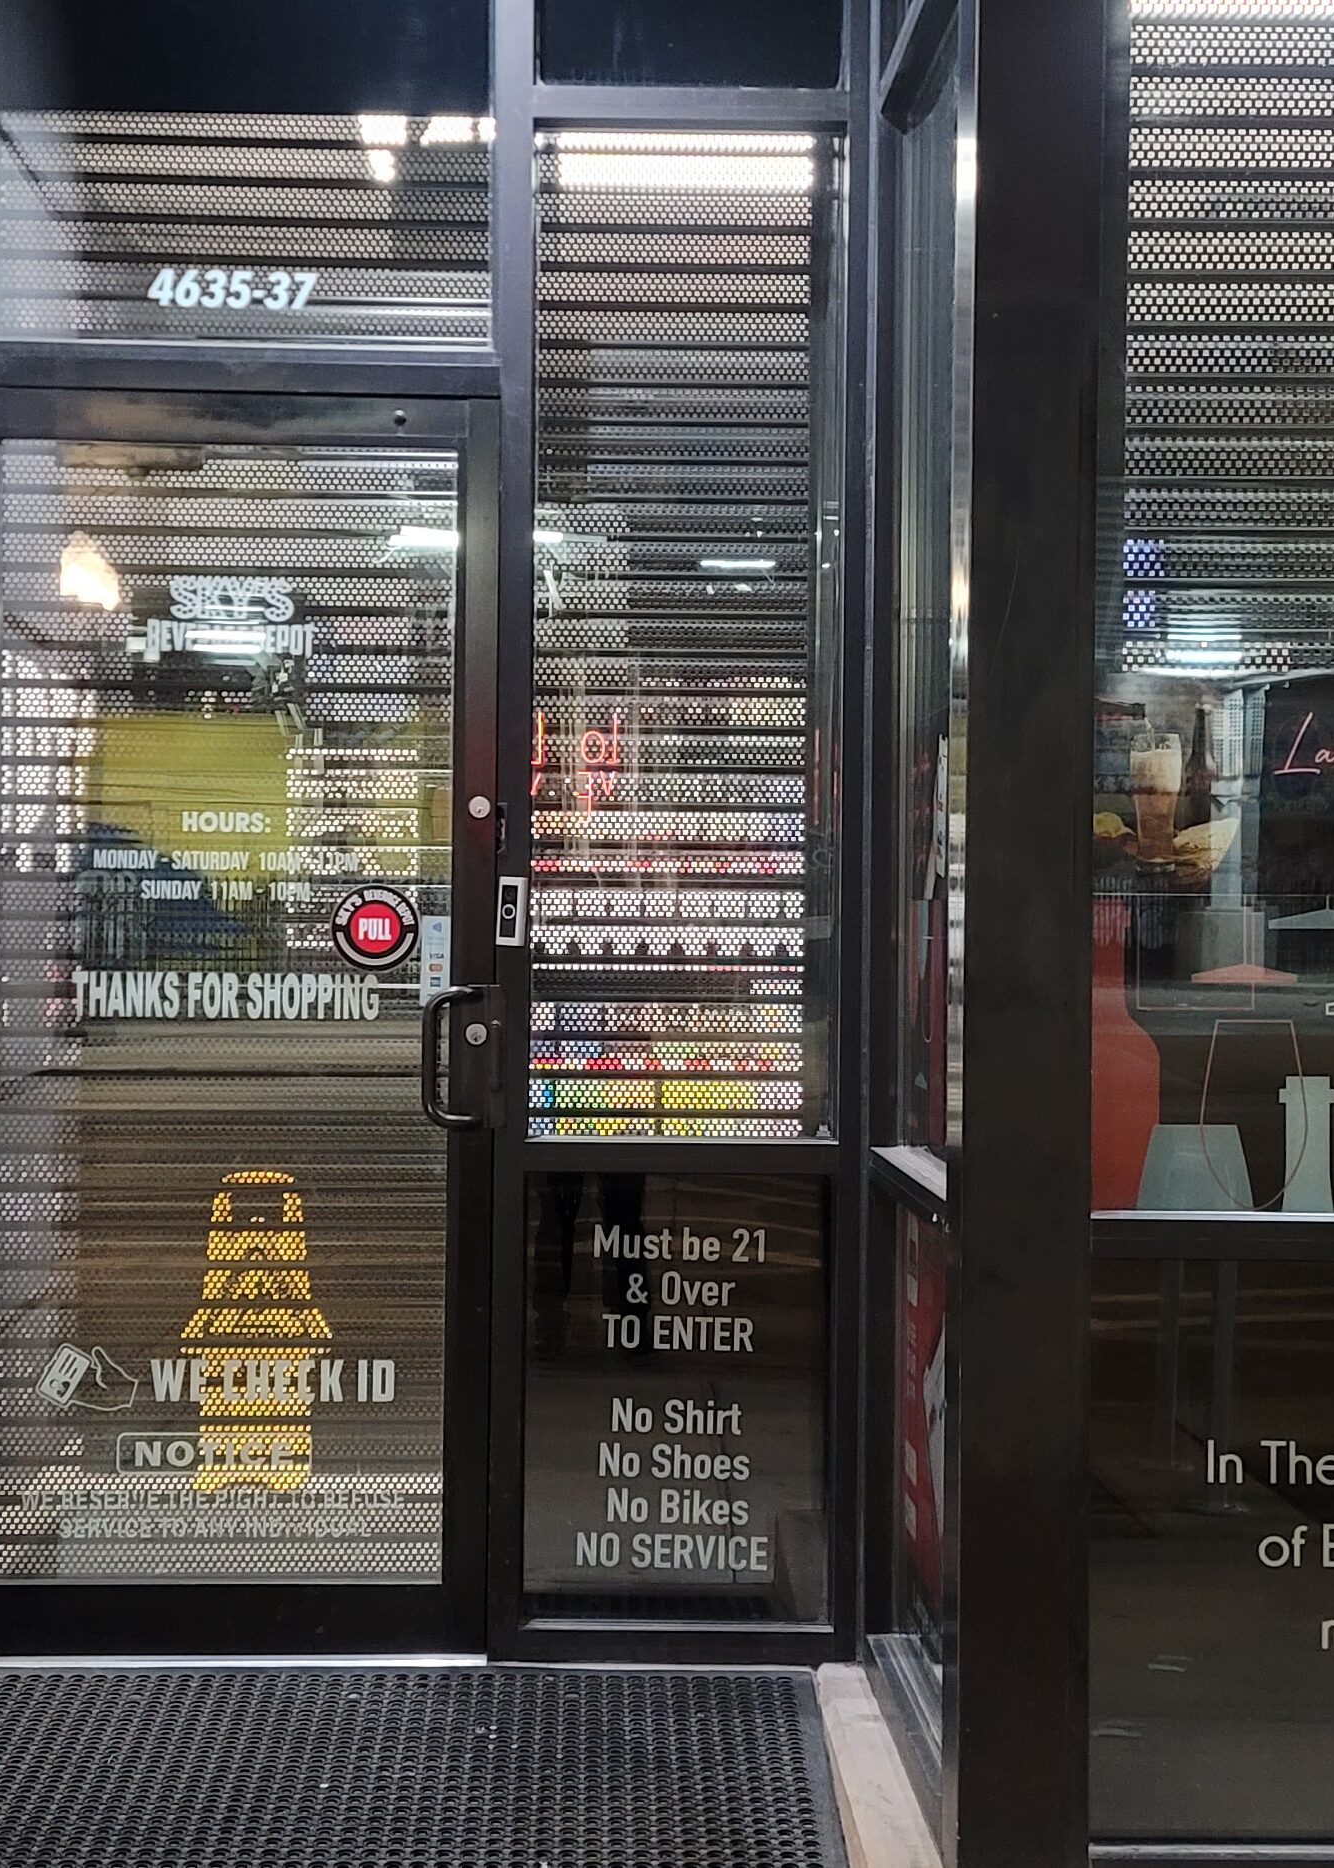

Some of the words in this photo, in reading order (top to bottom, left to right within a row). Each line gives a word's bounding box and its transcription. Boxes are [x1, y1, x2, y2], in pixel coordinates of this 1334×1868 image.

[147, 268, 319, 310] 4635-37
[181, 811, 271, 833] HOURS:
[93, 849, 158, 870] MONDAY
[171, 851, 249, 871] SATURDAY
[259, 852, 301, 872] 10AM
[140, 880, 202, 901] SUNDAY
[211, 881, 253, 901] 11AM
[358, 917, 392, 941] PULL
[72, 972, 179, 1018] THANKS
[188, 972, 239, 1019] FOR
[247, 973, 380, 1020] SHOPPING
[593, 1224, 672, 1260] Must
[683, 1227, 721, 1262] be
[732, 1229, 766, 1263] 21
[626, 1273, 649, 1304] &
[661, 1271, 736, 1306] Over
[602, 1313, 640, 1349] TO
[653, 1315, 754, 1352] ENTER
[150, 1358, 216, 1402] WE
[220, 1358, 344, 1402] CHECK
[358, 1359, 396, 1403] ID
[611, 1397, 653, 1433] No
[663, 1399, 742, 1435] Shirt
[134, 1440, 295, 1467] NOTICE
[598, 1442, 641, 1478] No
[651, 1443, 750, 1481] Shoes
[1206, 1440, 1244, 1485] In
[20, 1490, 55, 1510] WE
[61, 1490, 161, 1510] RESERVE
[169, 1490, 210, 1510] THE
[606, 1487, 649, 1523] No
[660, 1489, 749, 1526] Bikes
[59, 1517, 152, 1539] SERVICE
[1258, 1524, 1309, 1569] of
[576, 1532, 620, 1567] NO
[631, 1533, 768, 1572] SERVICE
